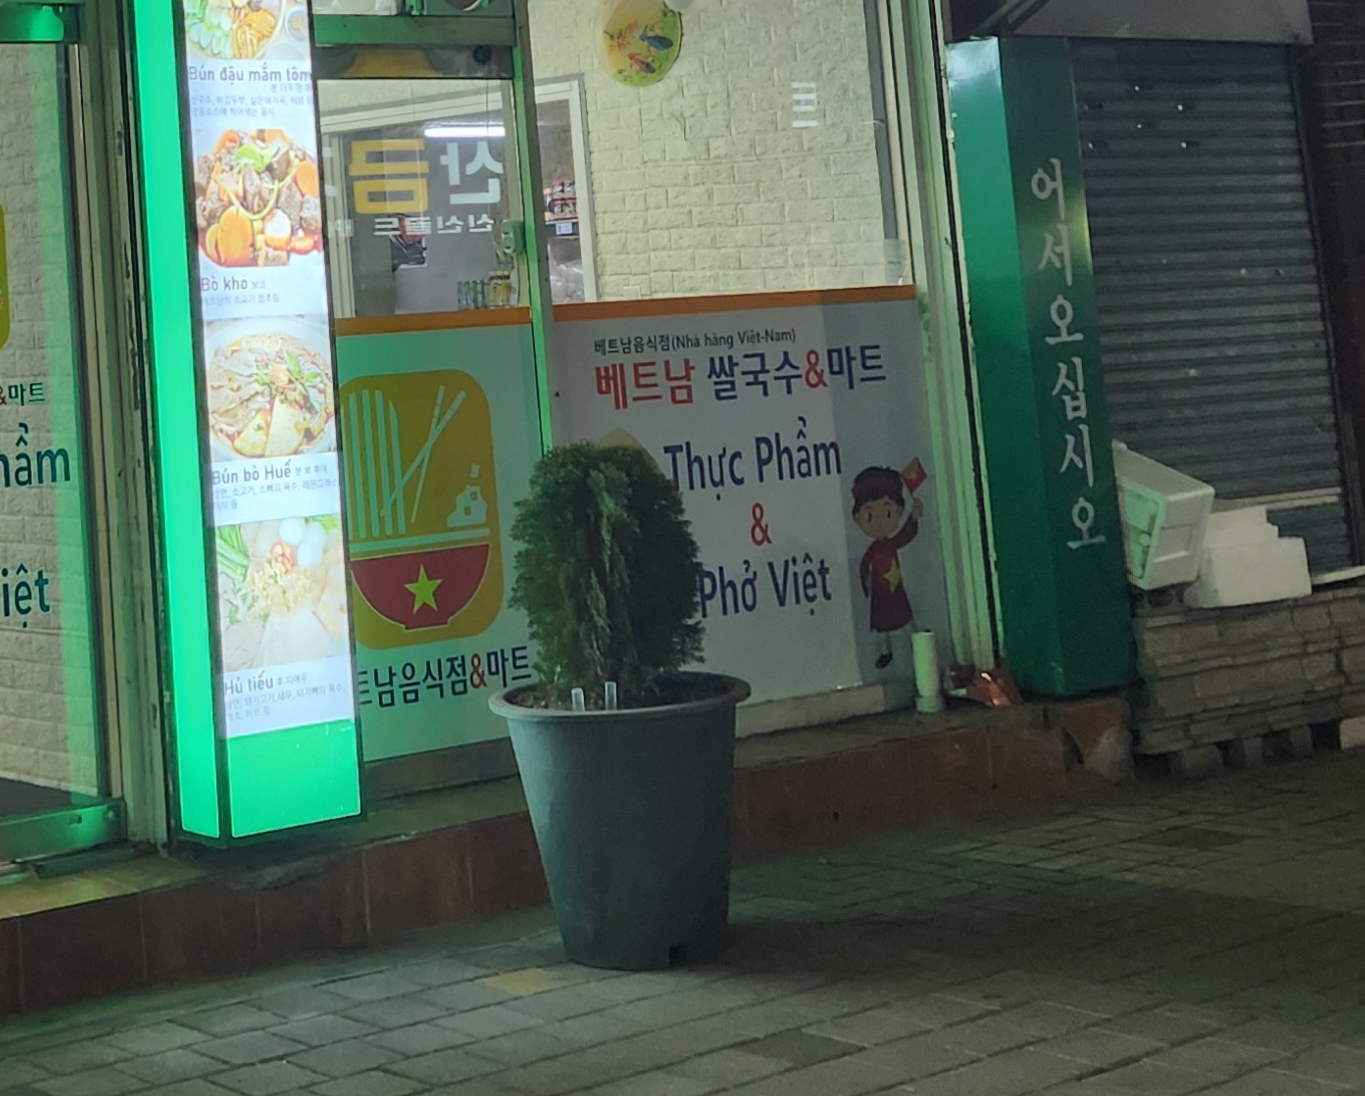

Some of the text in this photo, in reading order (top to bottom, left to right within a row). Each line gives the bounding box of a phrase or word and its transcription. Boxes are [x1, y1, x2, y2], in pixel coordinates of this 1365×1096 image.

[188, 64, 215, 81] Bún
[219, 64, 244, 86] đậu
[200, 274, 219, 292] Bò
[223, 275, 248, 291] kho
[703, 330, 735, 351] hàng
[737, 327, 796, 348] Việt-Nam)
[1029, 157, 1107, 550] 어서오십시오
[594, 344, 887, 410] 베트남 쌀국수&마트
[212, 466, 239, 486] Bún
[243, 463, 260, 483] bò
[264, 457, 292, 481] Huế
[663, 415, 843, 502] Thực Phẩm
[749, 502, 773, 548] &
[698, 552, 832, 619] Phở Việt
